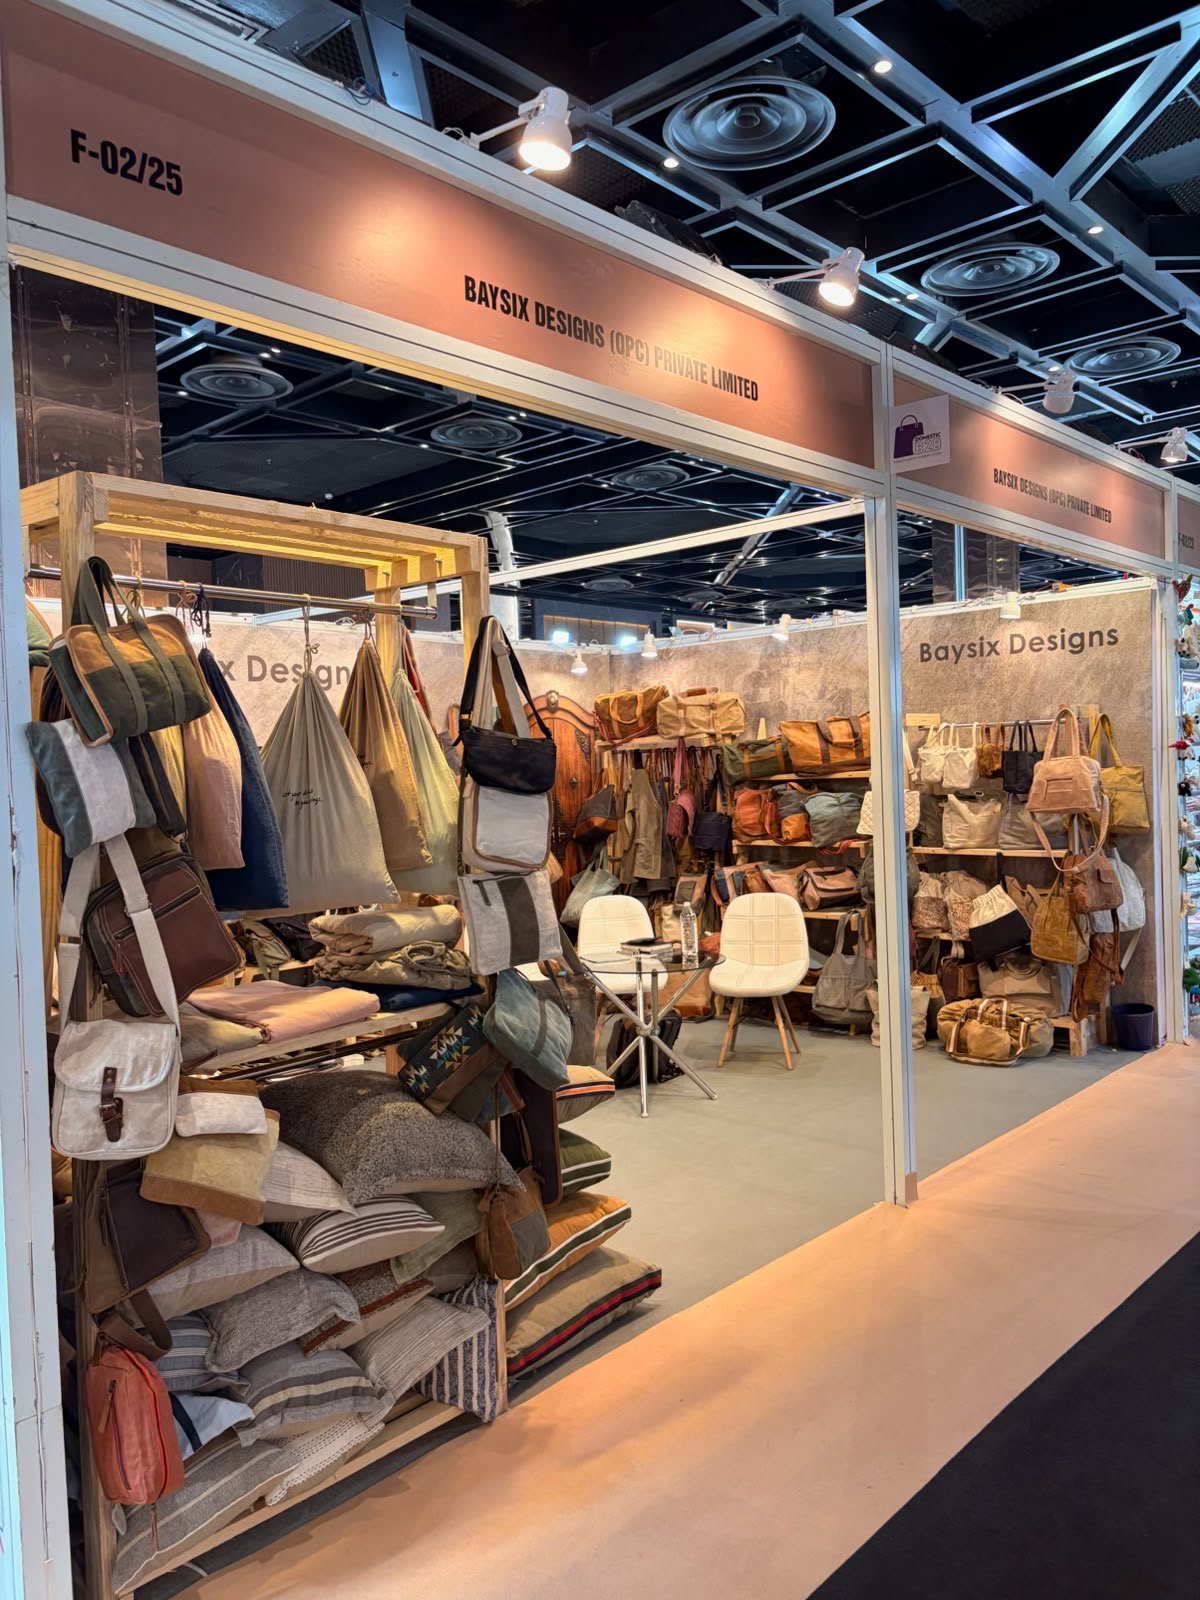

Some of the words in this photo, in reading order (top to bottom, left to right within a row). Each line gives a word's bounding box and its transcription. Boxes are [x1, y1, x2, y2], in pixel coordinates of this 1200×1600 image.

[70, 128, 183, 196] F-02/25
[464, 275, 530, 322] BAYSIX
[534, 301, 605, 348] DESIGNS
[610, 330, 650, 367] (OPC)
[654, 344, 708, 385] PRIVATE
[711, 365, 758, 402] LIMITED
[914, 431, 941, 442] DOMESTIC
[914, 438, 942, 455] B2B
[993, 468, 1019, 491] BAYSIX
[1020, 478, 1048, 501] DESIGNS
[1049, 487, 1066, 509] (OPC)
[1067, 494, 1090, 515] PRIVATE
[1091, 503, 1112, 523] LIMITED
[920, 636, 1000, 664] Baysix
[1009, 628, 1119, 655] Designs
[247, 655, 351, 691] Desgn
